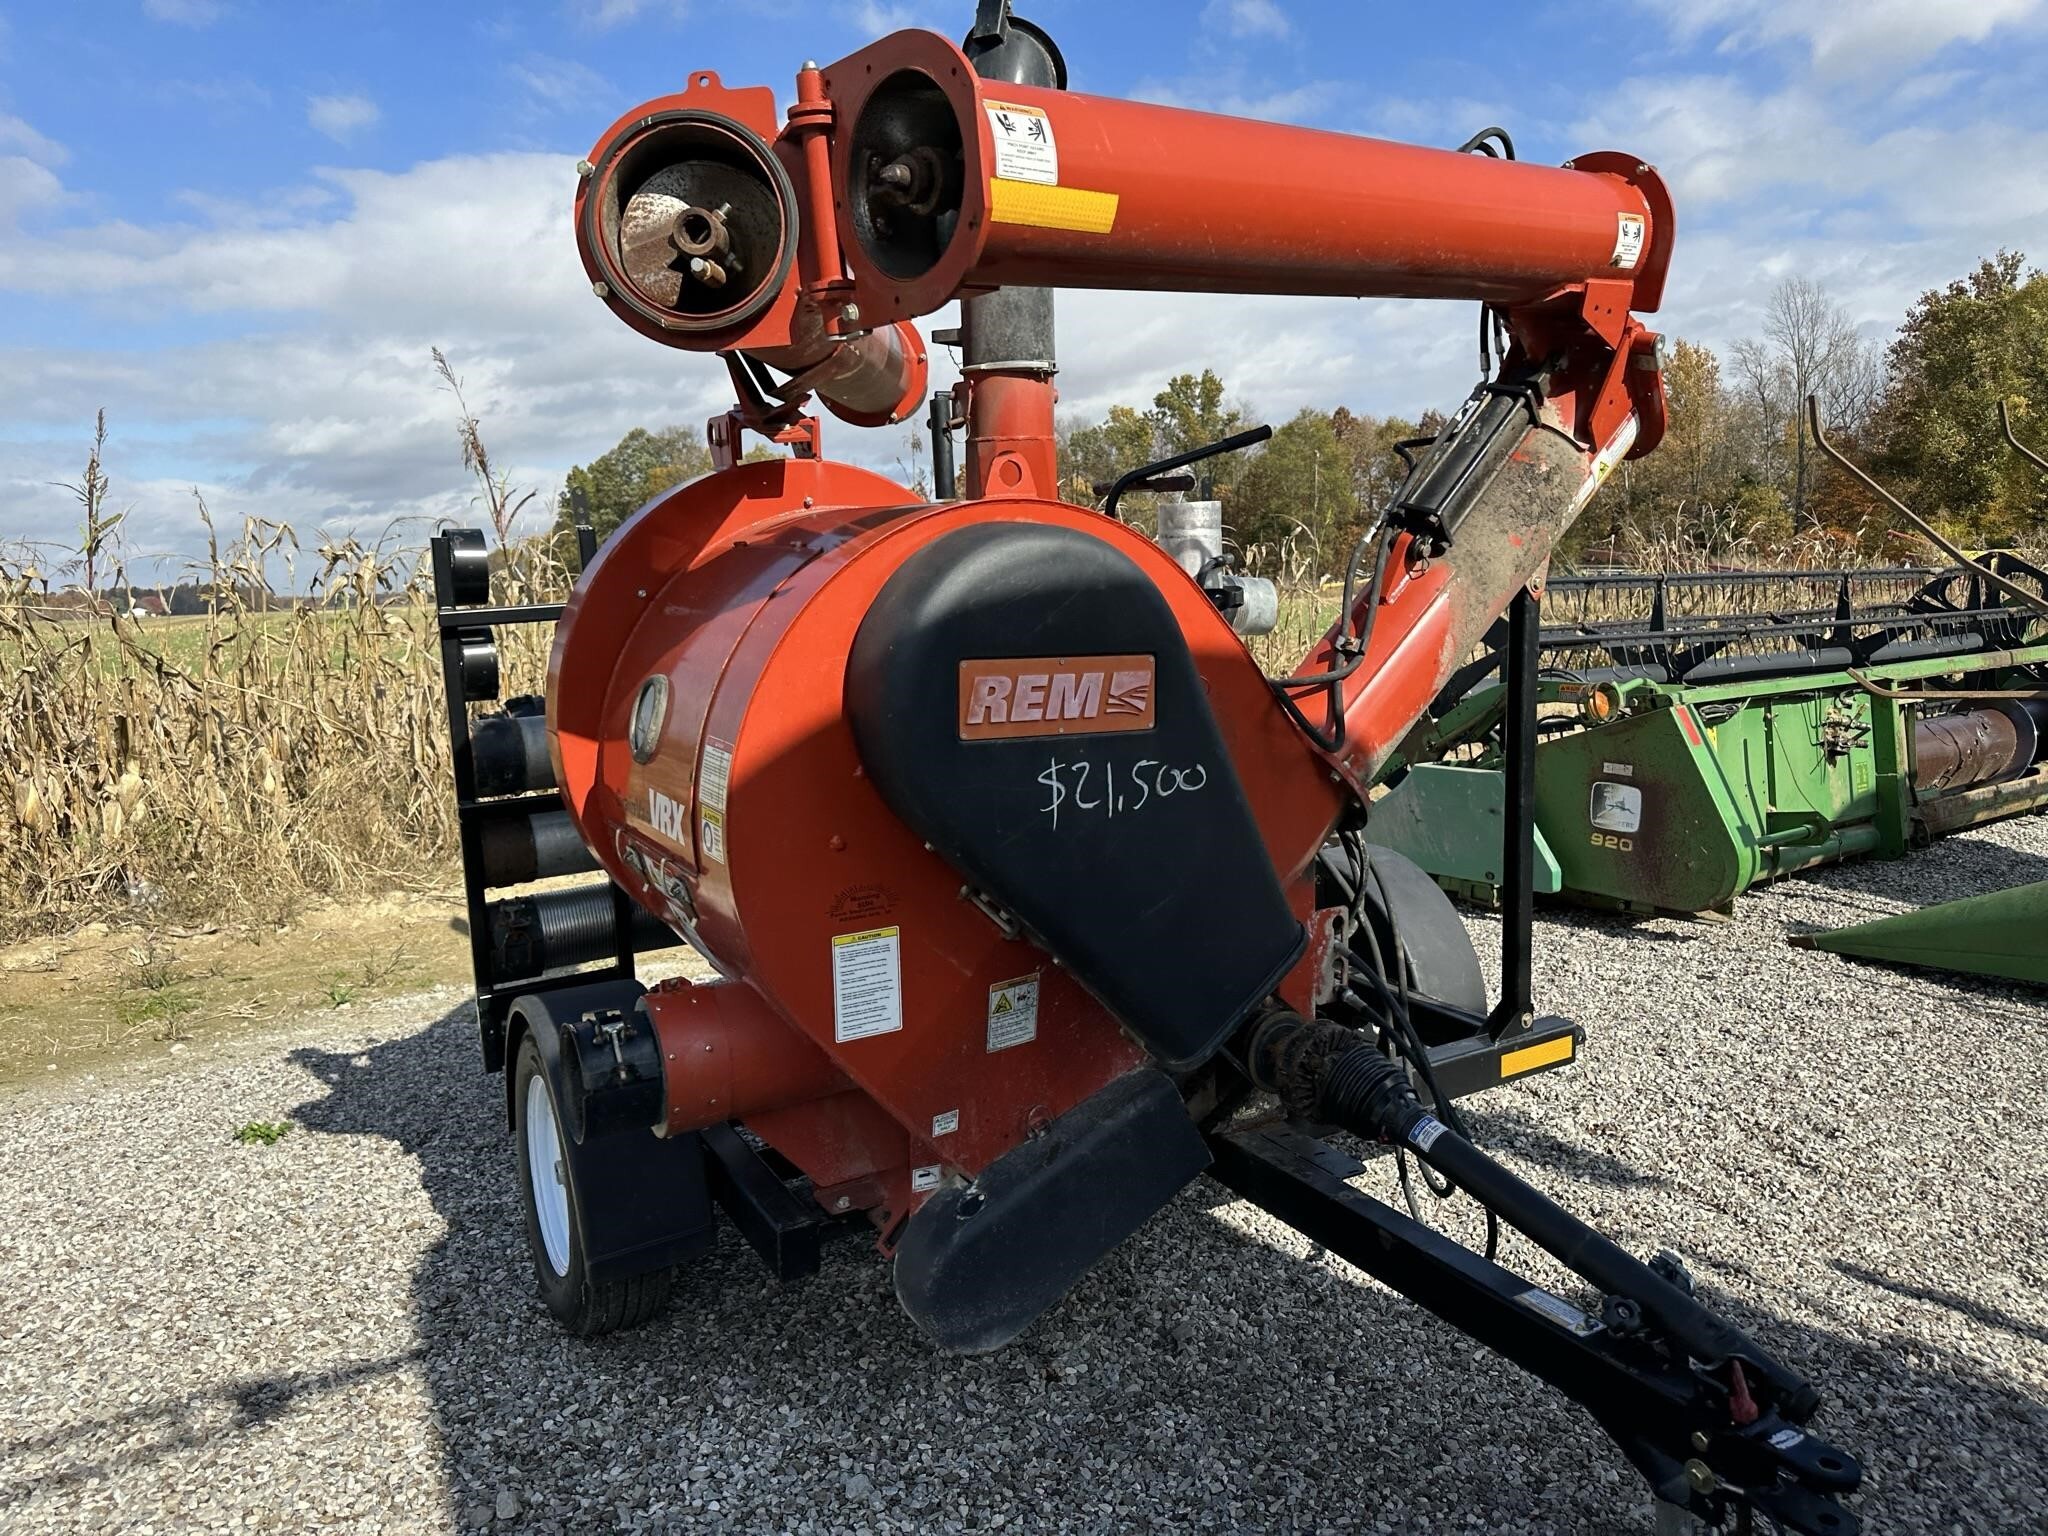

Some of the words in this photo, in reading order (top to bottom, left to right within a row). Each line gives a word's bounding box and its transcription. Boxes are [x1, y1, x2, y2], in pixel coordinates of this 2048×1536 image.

[966, 672, 1105, 725] REM
[648, 787, 686, 848] VRX
[1037, 757, 1207, 831] $21,500
[1590, 832, 1633, 852] 920
[857, 932, 882, 941] CAUTION
